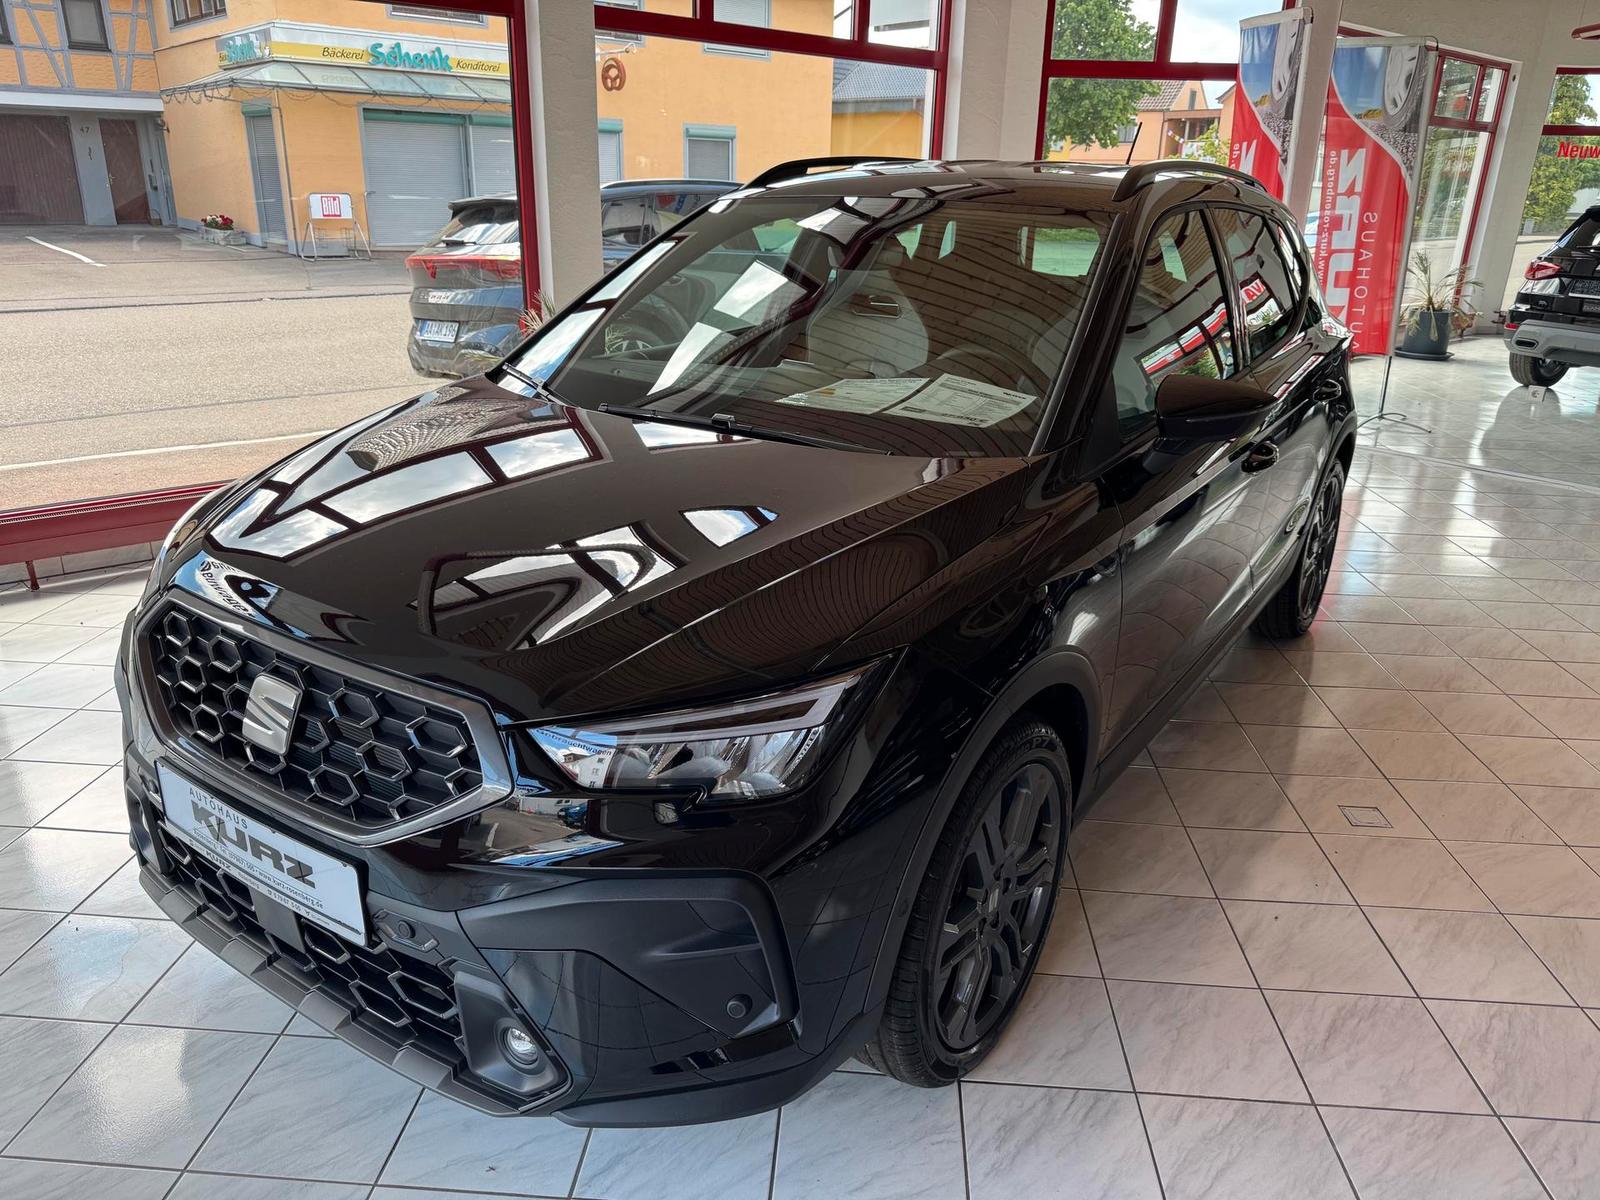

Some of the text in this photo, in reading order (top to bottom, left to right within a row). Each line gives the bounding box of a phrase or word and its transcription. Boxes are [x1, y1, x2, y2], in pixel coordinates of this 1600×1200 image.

[322, 42, 501, 73] Bäckerei Schenk Konditorei
[322, 197, 340, 215] Bild
[189, 787, 248, 829] AUTOHAUS
[191, 799, 316, 889] KURZ
